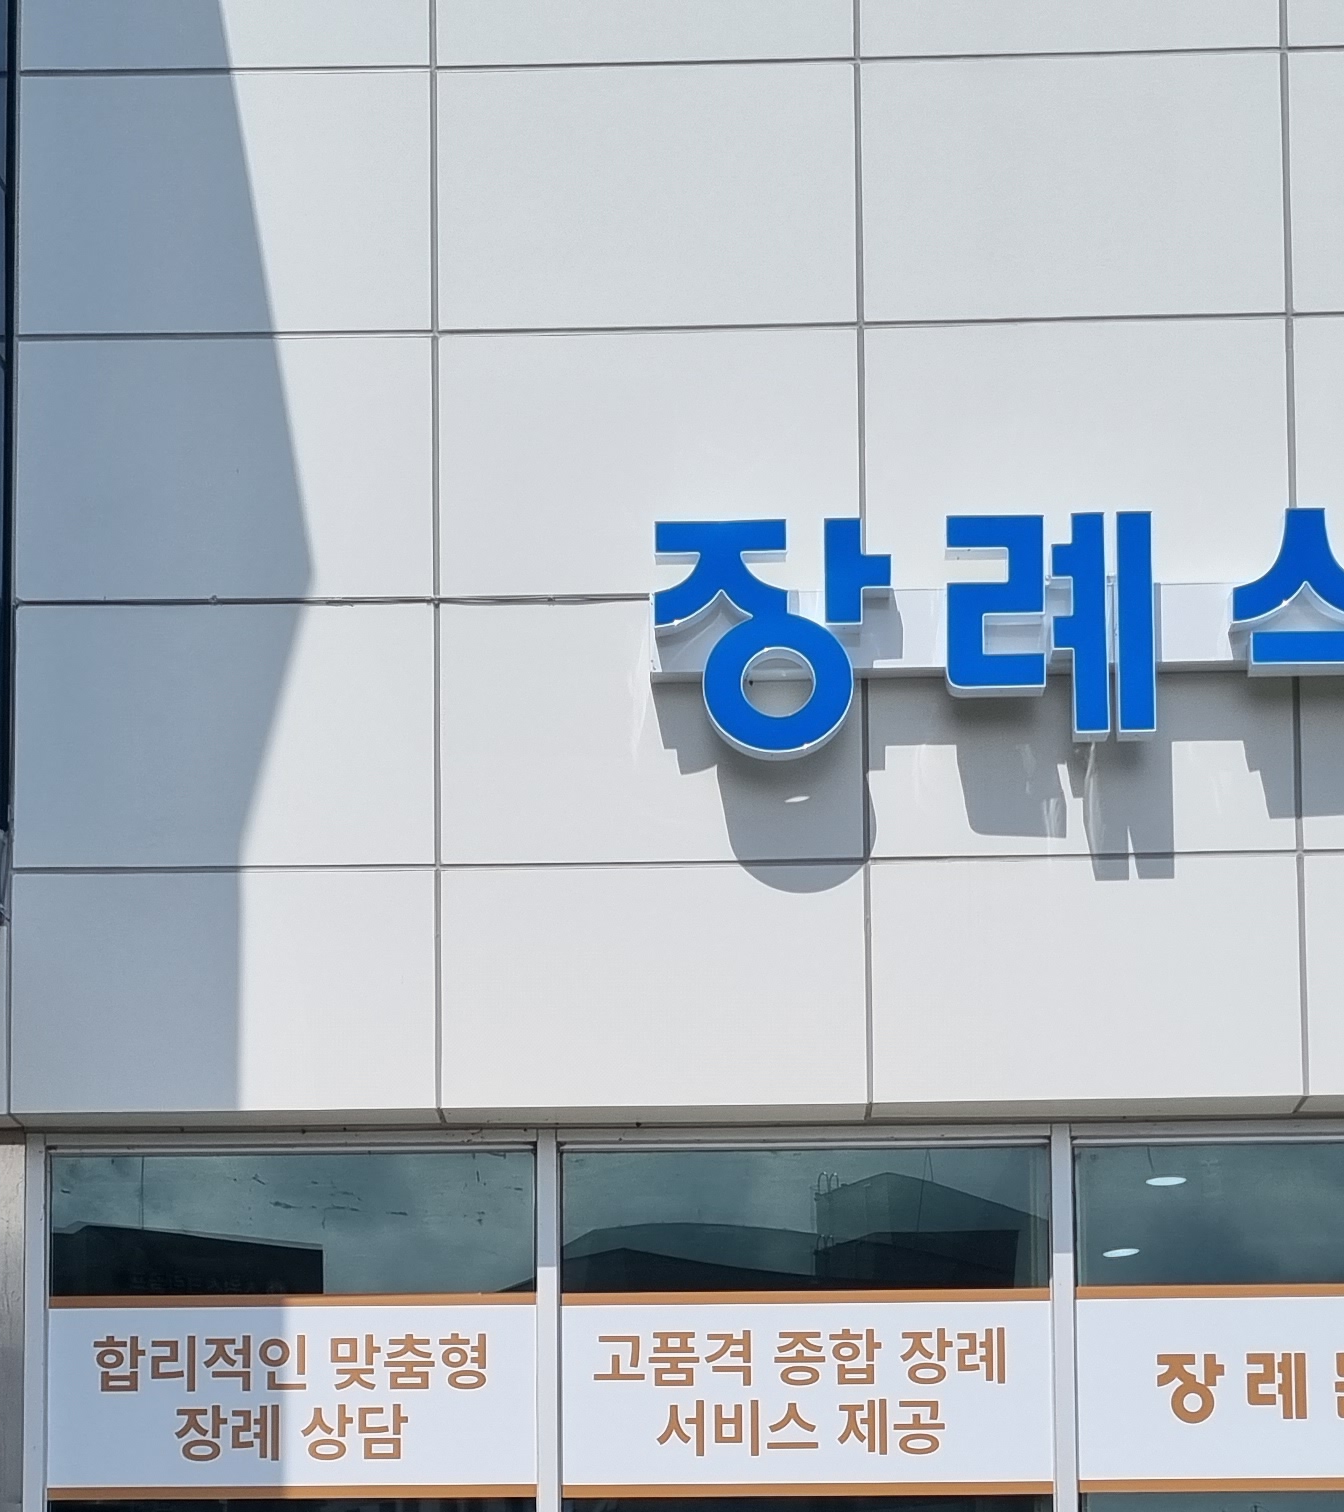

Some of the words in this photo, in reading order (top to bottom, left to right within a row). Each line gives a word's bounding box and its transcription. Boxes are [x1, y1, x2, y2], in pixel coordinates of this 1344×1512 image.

[92, 1333, 309, 1393] 합리적인
[328, 1332, 490, 1392] 맞춤형
[592, 1330, 755, 1389] 고품격
[772, 1327, 883, 1387] 종합
[899, 1326, 1008, 1386] 장례
[173, 1404, 284, 1462] 장례
[299, 1403, 409, 1461] 상담
[656, 1399, 820, 1458] 서비스
[837, 1397, 947, 1456] 제공
